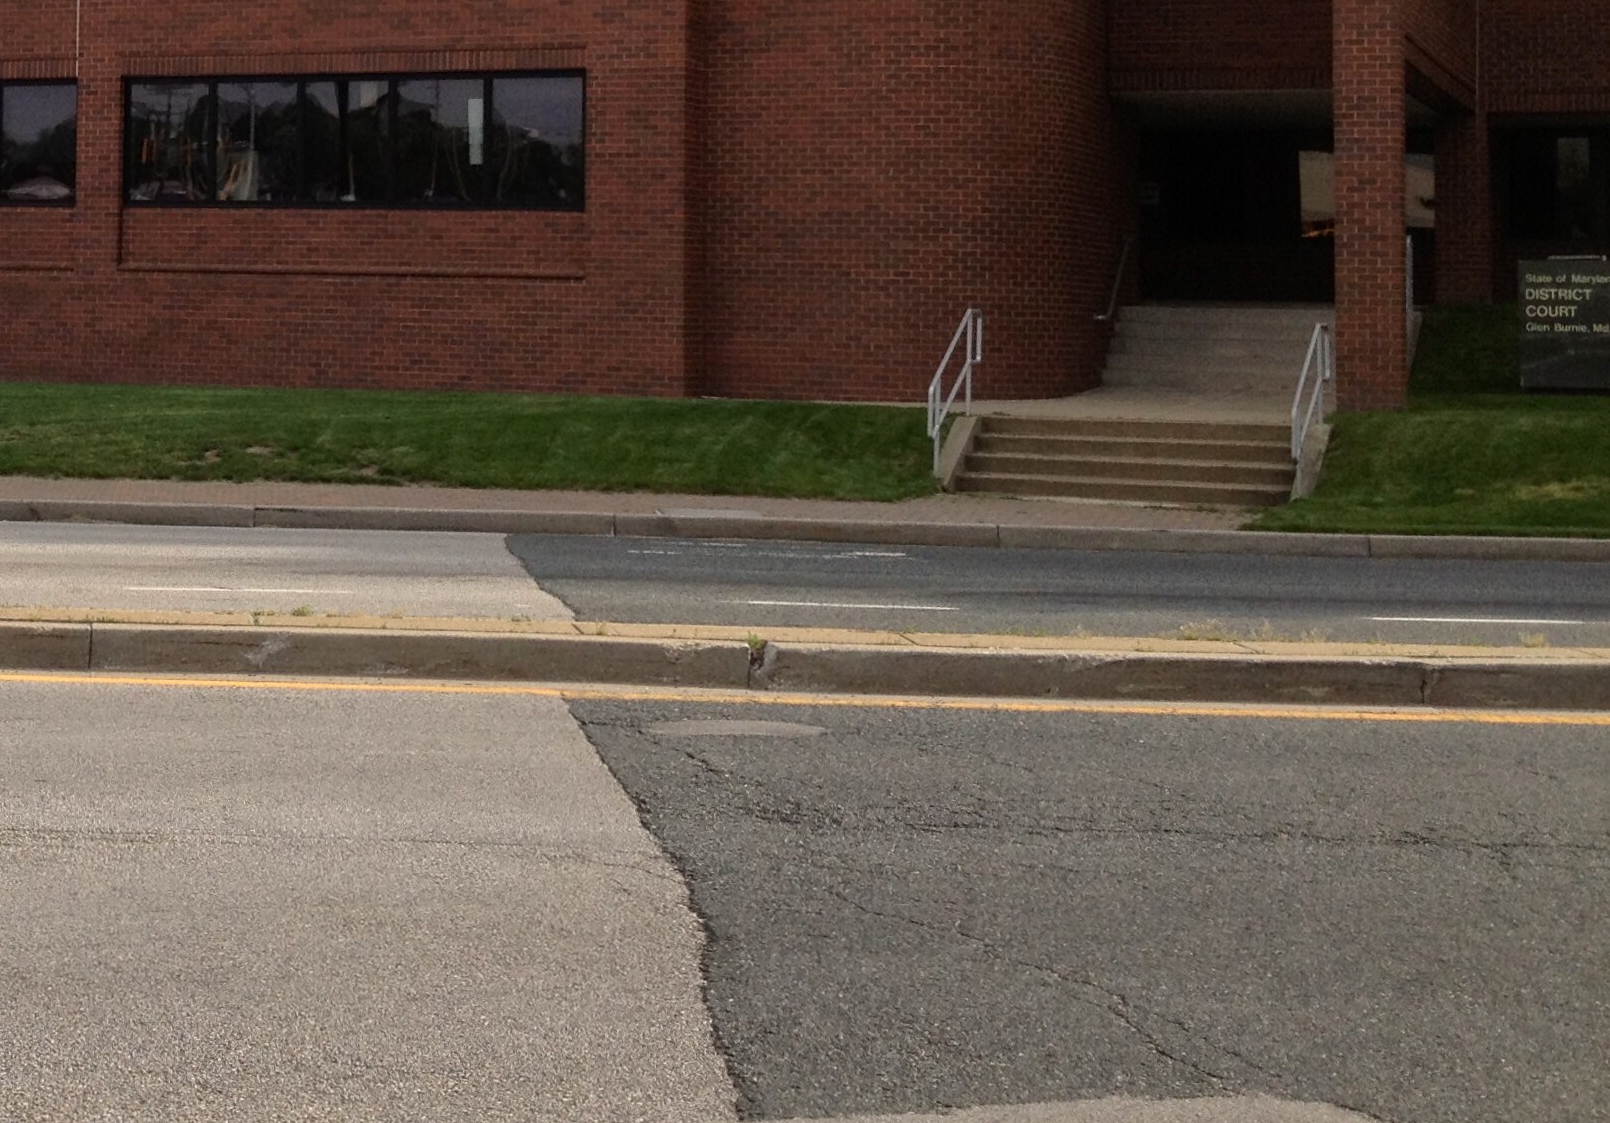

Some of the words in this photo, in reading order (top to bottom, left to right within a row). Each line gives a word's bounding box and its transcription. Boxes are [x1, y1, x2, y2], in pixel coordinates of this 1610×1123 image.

[1525, 273, 1552, 283] State
[1555, 274, 1566, 283] of
[1525, 288, 1592, 301] DISTRICT
[1525, 305, 1578, 318] COURT
[1525, 322, 1550, 332] Glen
